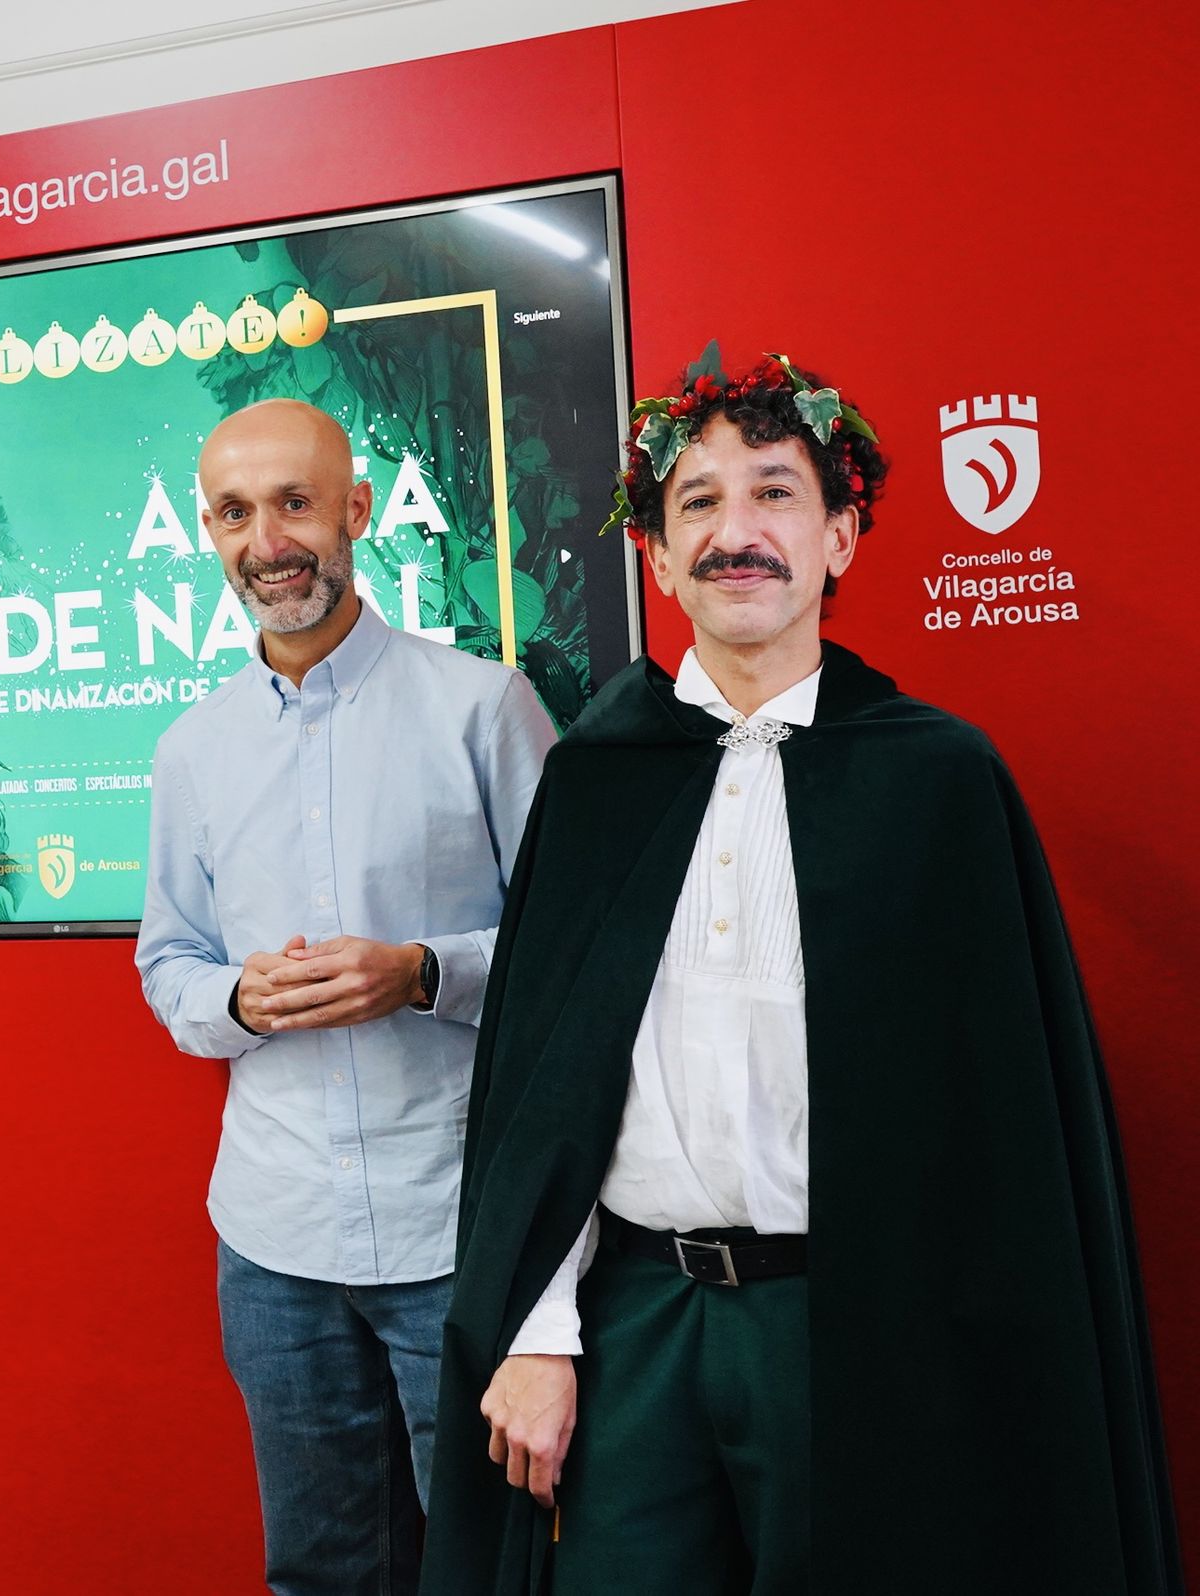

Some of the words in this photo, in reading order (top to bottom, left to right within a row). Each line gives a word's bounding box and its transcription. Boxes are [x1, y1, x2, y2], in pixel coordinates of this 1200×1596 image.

[513, 308, 561, 326] Siguiente
[942, 549, 1023, 569] Concello
[1029, 547, 1053, 562] de
[923, 566, 1075, 602] Vilagarcía
[924, 606, 961, 631] de
[970, 601, 1080, 627] Arousa
[15, 675, 173, 712] DINAMIZACIÓN
[180, 678, 210, 702] DE
[34, 777, 77, 793] CONCERTOS
[85, 773, 142, 790] ESPECTÁCULOS
[79, 859, 94, 872] de
[97, 859, 140, 871] Arousa
